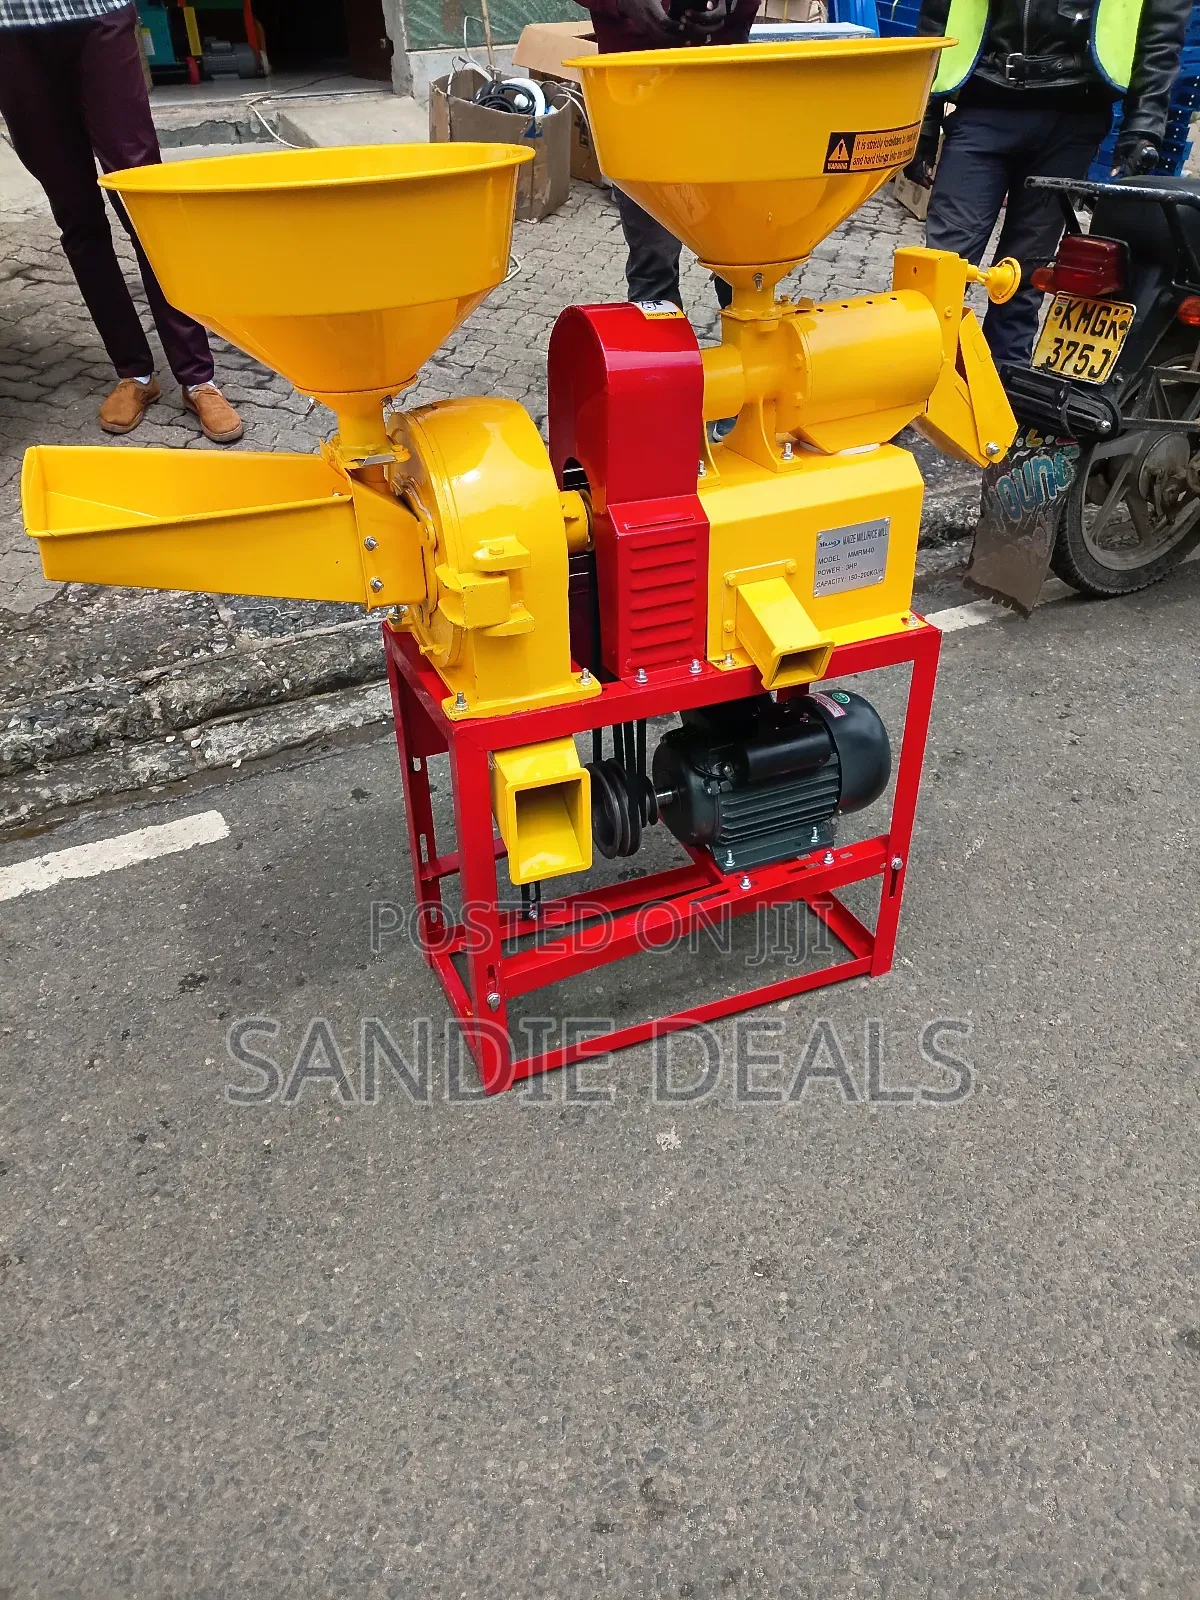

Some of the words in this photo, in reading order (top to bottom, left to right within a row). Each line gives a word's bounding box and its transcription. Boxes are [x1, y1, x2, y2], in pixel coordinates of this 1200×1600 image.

[861, 138, 866, 150] is
[866, 137, 883, 150] strictly
[852, 154, 863, 165] and
[863, 153, 875, 165] hard
[1059, 300, 1128, 340] KMGK
[1046, 337, 1112, 378] 375J
[842, 533, 857, 545] MAIZE
[878, 527, 888, 538] MILL
[847, 547, 875, 559] MMRM40
[845, 562, 858, 571] 3HP
